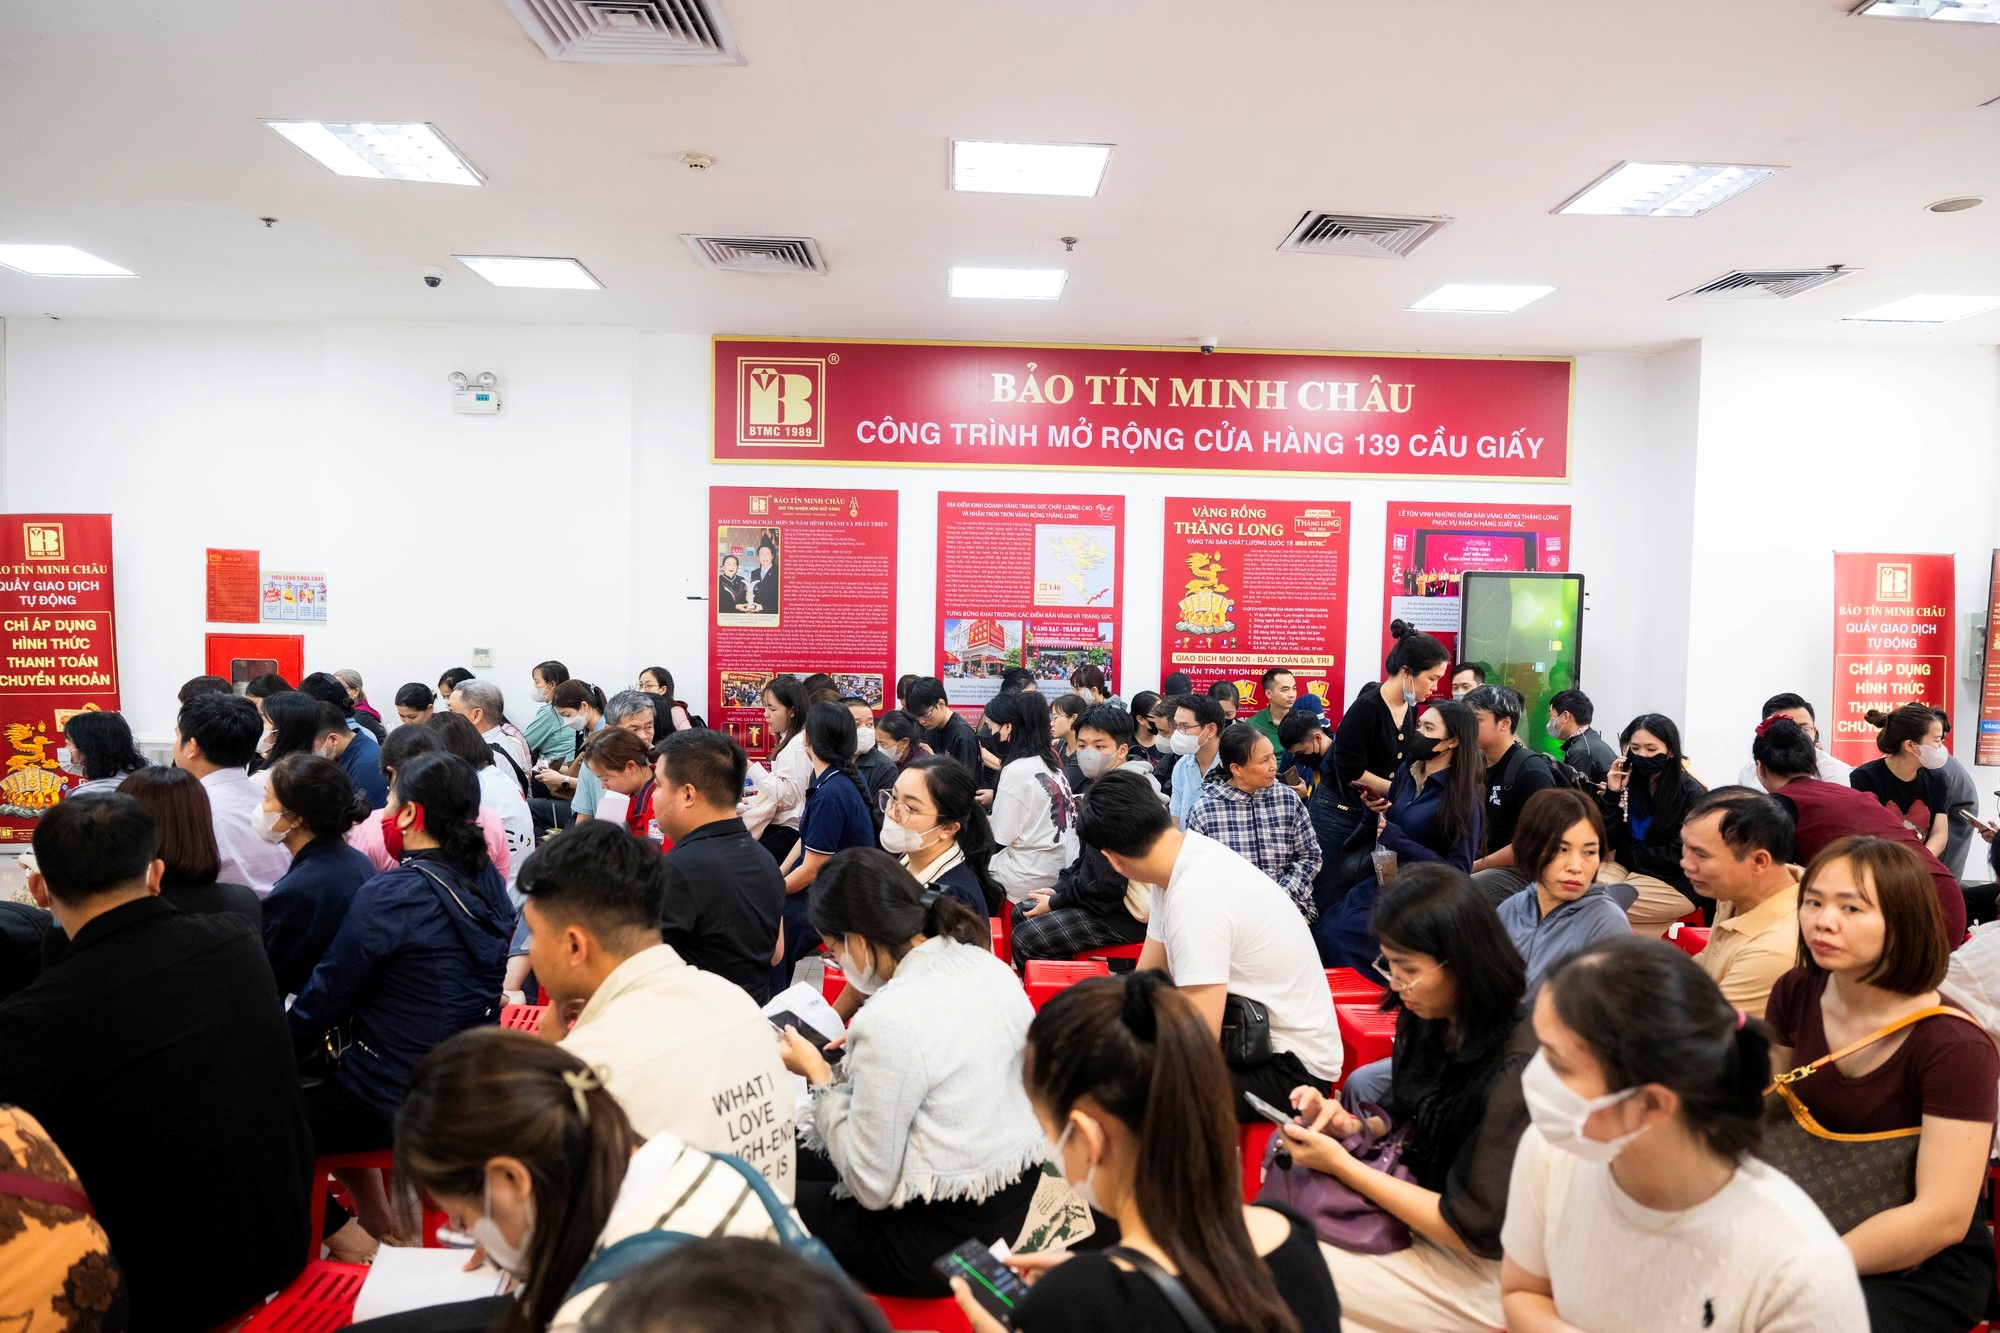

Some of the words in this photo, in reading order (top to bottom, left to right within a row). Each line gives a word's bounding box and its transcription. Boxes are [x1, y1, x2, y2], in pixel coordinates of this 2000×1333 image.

[991, 363, 1074, 407] BẢO
[1085, 368, 1159, 406] TÍN
[1169, 378, 1288, 415] MINH
[1297, 376, 1415, 416] CHÂU
[750, 426, 780, 436] BTMC
[784, 427, 812, 437] 1989
[857, 419, 940, 444] CÔNG
[950, 420, 1037, 446] TRÌNH
[1048, 422, 1092, 448] MỞ
[1102, 423, 1184, 453] RỘNG
[1194, 424, 1253, 452] CỬA
[1263, 425, 1344, 454] HÀNG
[1355, 434, 1400, 456] 139
[1409, 428, 1467, 457] CẦU
[1477, 429, 1543, 458] GIẤY
[825, 497, 844, 505] CHÂU
[1192, 506, 1227, 517] VÀNG
[1230, 505, 1266, 518] RỒNG
[1503, 512, 1521, 521] RỒNG
[1173, 520, 1233, 535] THĂNG
[1238, 523, 1284, 536] LONG
[1513, 520, 1525, 528] SẮC
[12, 565, 34, 574] TÍN
[36, 565, 70, 574] MINH
[72, 564, 107, 574] CHÂU
[0, 579, 30, 591] QUẦY
[34, 581, 64, 591] GIAO
[68, 581, 99, 593] DỊCH
[19, 595, 36, 607] TỰ
[39, 594, 76, 607] ĐỘNG
[1839, 605, 1862, 616] BẢO
[1864, 605, 1882, 616] TÍN
[1884, 607, 1914, 617] MINH
[1916, 605, 1946, 617] CHÂU
[4, 617, 29, 631] CHỈ
[32, 617, 51, 631] ÁP
[55, 620, 97, 633] DỤNG
[1846, 621, 1878, 633] QUẦY
[1880, 623, 1909, 634] GIAO
[1911, 624, 1937, 636] DỊCH
[12, 636, 47, 649] HÌNH
[50, 635, 90, 649] THỨC
[1867, 638, 1882, 650] TỰ
[1883, 638, 1917, 650] ĐỘNG
[6, 657, 55, 668] THANH
[58, 654, 98, 667] TOÁN
[1198, 655, 1218, 664] DỊCH
[1219, 656, 1234, 664] MỌI
[1257, 655, 1275, 663] BẢO
[1276, 655, 1298, 664] TOÀN
[1301, 656, 1316, 664] GIÁ
[1317, 657, 1330, 665] TRỊ
[1849, 661, 1872, 676] CHỈ
[1876, 660, 1893, 676] ÁP
[1896, 664, 1931, 678] DỤNG
[0, 672, 55, 686] CHUYỂN
[60, 672, 110, 686] KHOẢN
[1856, 680, 1887, 694] HÌNH
[1891, 682, 1925, 694] THỨC
[1848, 702, 1893, 714] THANH
[712, 1075, 764, 1116] WHAT
[766, 1072, 774, 1091] I
[728, 1101, 775, 1142] LOVE
[777, 1154, 788, 1179] IS
